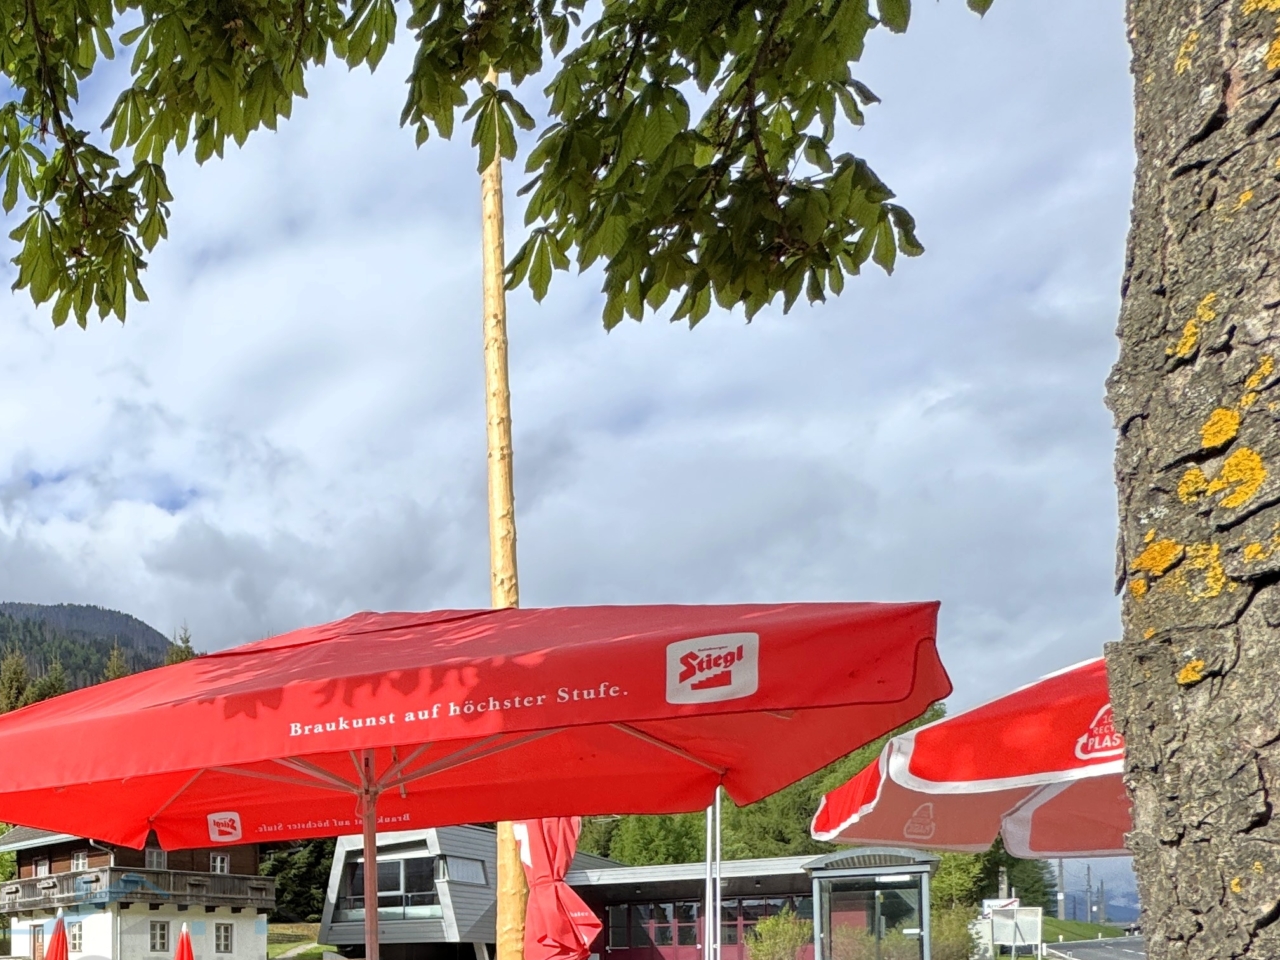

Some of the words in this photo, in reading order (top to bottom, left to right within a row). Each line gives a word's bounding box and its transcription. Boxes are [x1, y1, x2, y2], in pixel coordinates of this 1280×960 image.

[678, 644, 744, 684] Stiegl
[288, 711, 396, 737] Braukunst
[404, 703, 442, 722] auf
[448, 692, 547, 716] höchster
[556, 681, 629, 703] Stufe.
